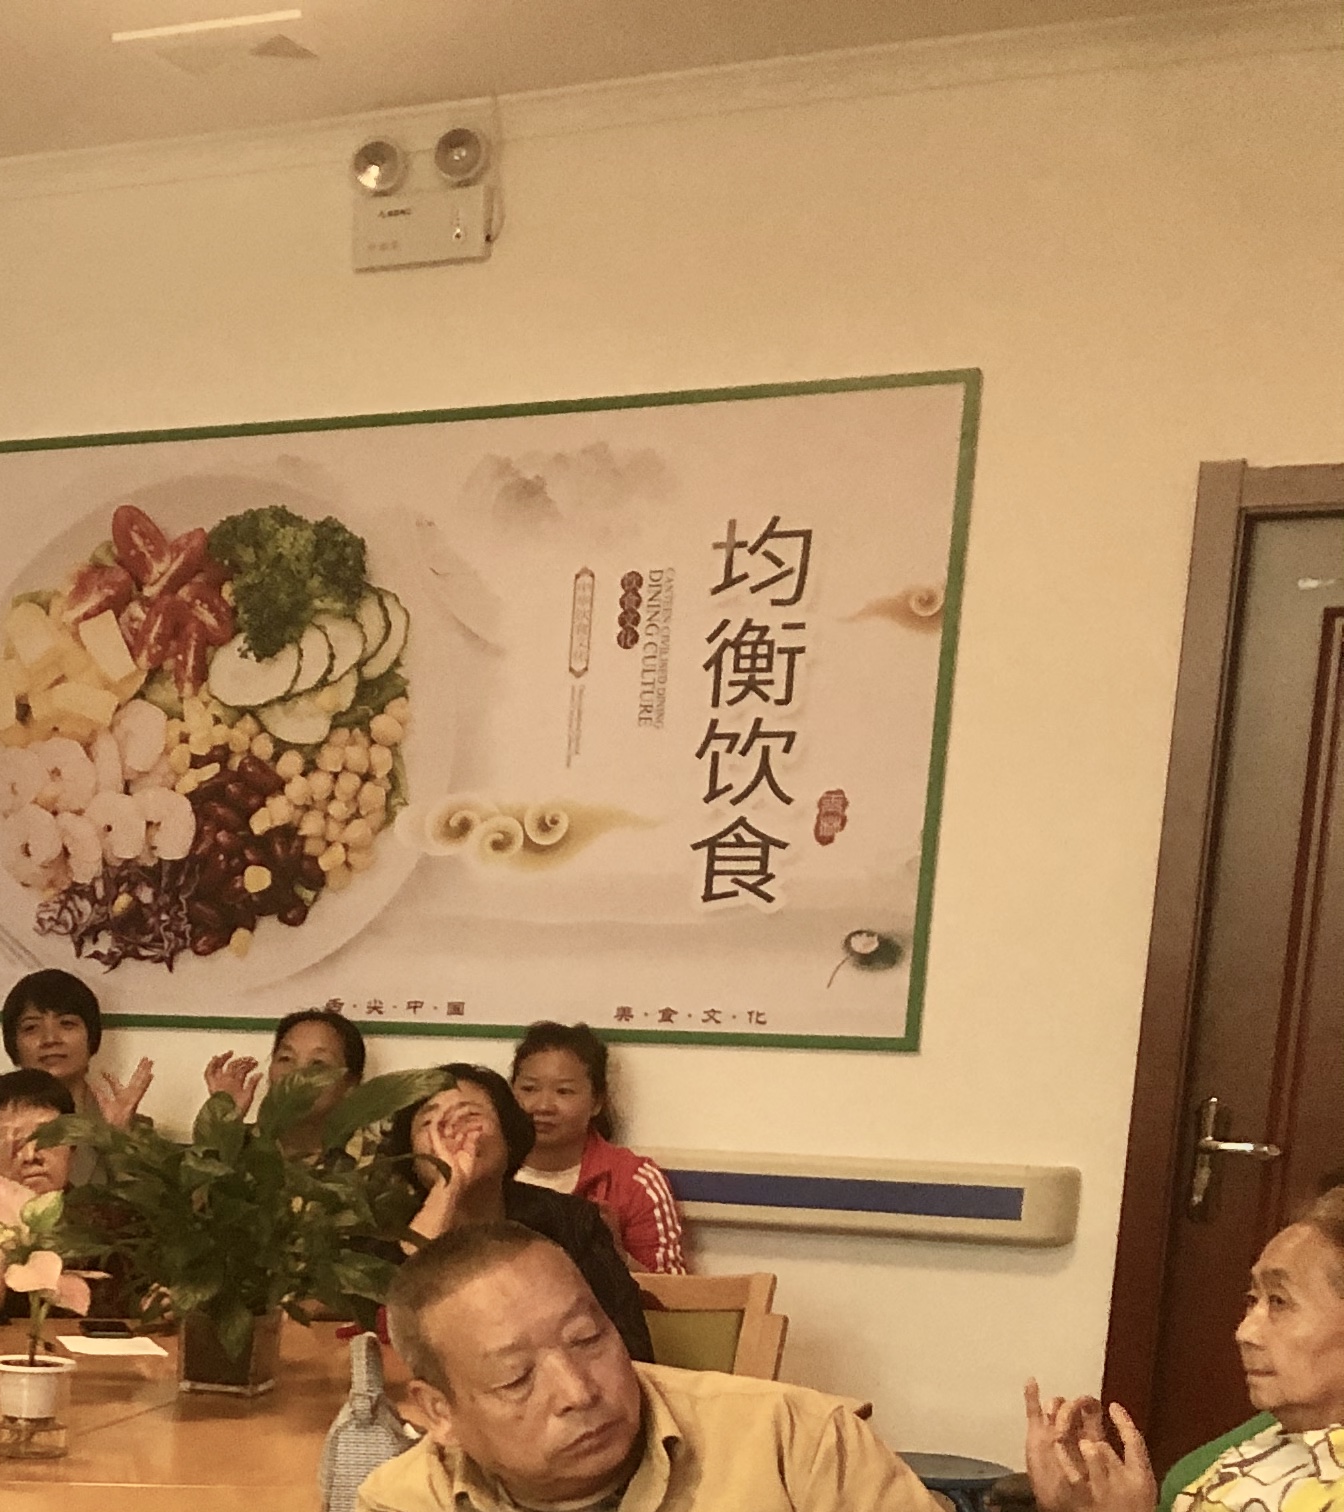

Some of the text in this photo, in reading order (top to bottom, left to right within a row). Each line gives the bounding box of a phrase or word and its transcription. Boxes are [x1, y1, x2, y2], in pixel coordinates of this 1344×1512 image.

[637, 569, 664, 727] DINING CULTURE
[690, 514, 813, 904] 均衡饮食
